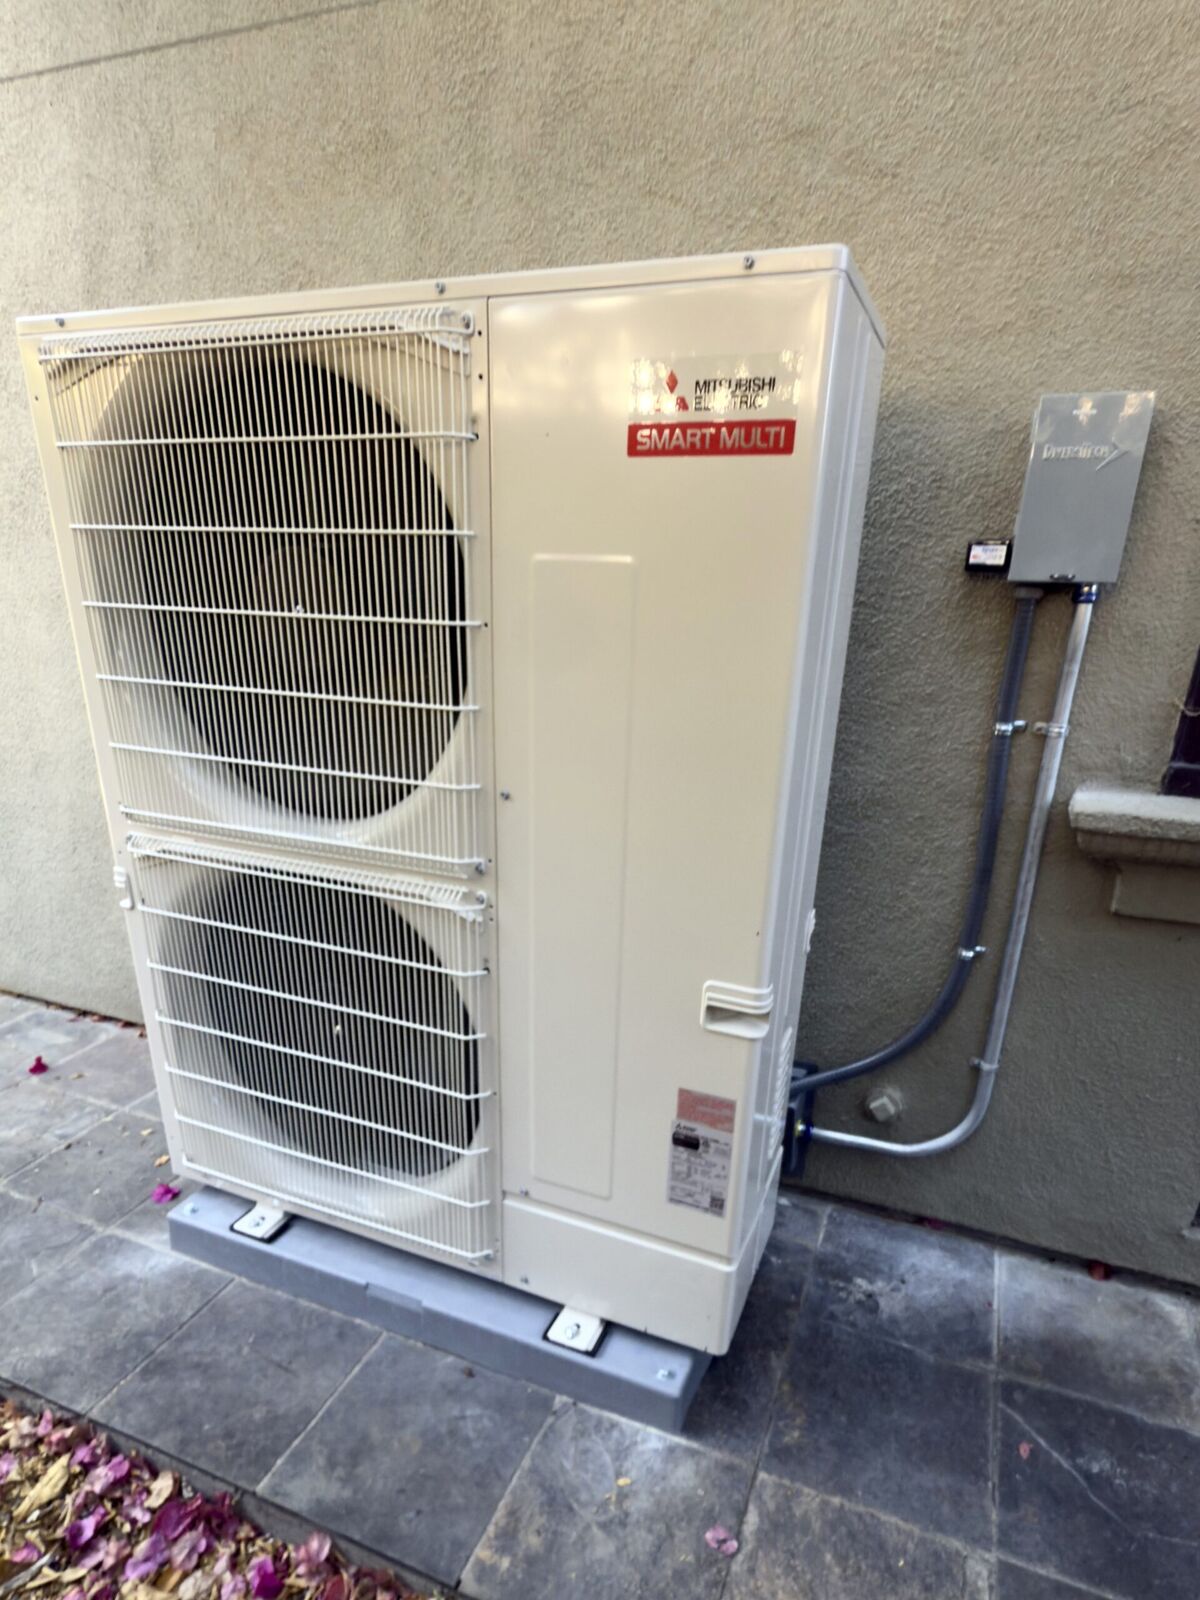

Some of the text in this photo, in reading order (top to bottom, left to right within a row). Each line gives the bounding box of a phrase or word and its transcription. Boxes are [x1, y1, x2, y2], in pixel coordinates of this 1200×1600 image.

[694, 376, 776, 395] MITSUBISHI
[694, 394, 764, 412] ELTRIC
[636, 426, 786, 451] SMART MULTI
